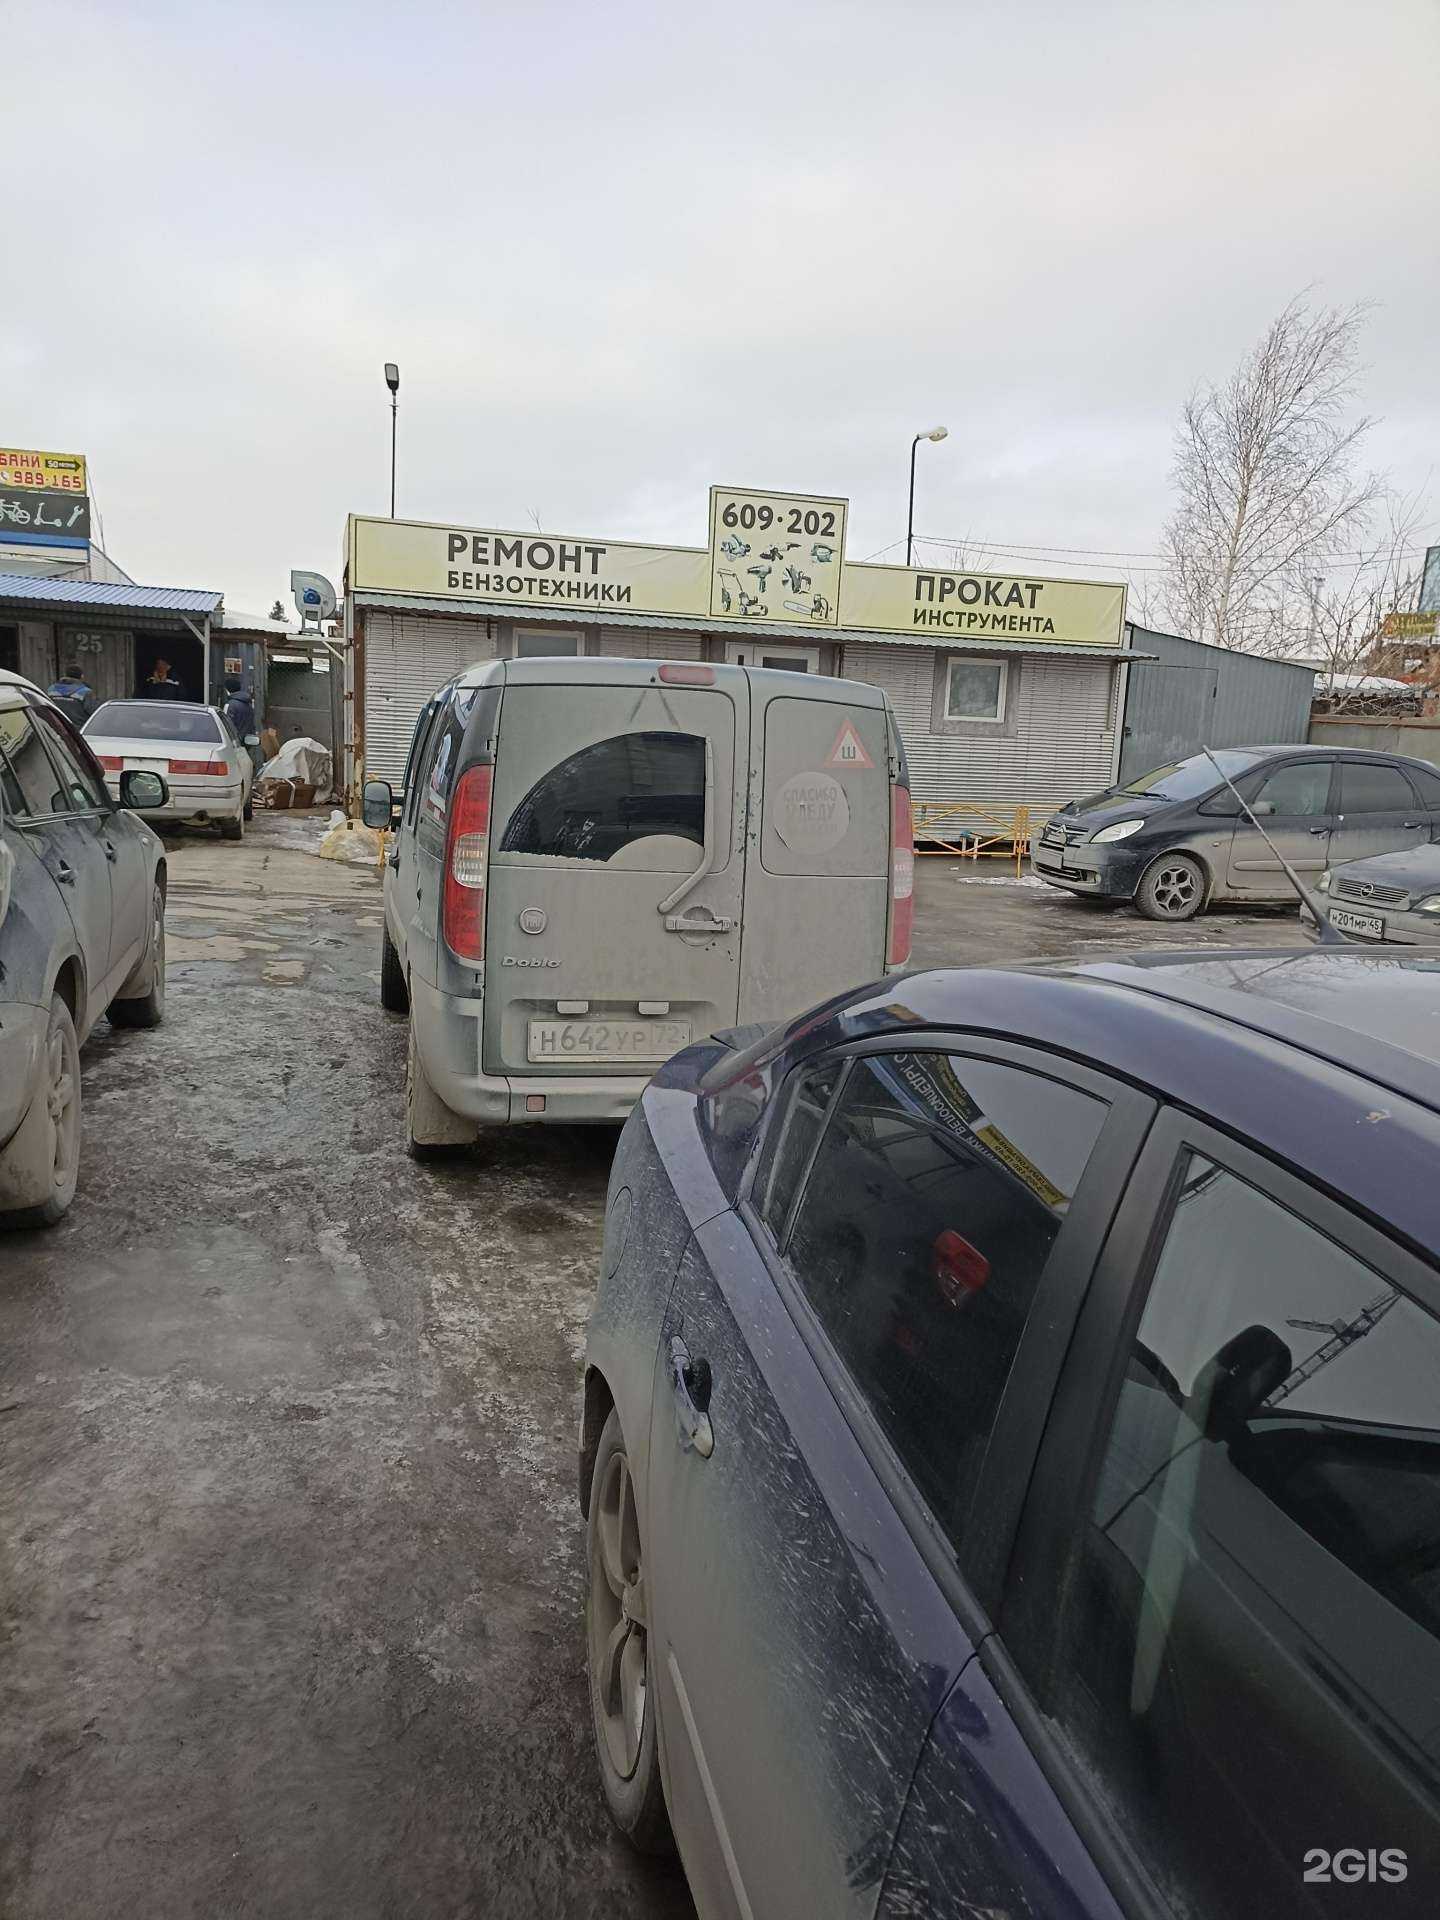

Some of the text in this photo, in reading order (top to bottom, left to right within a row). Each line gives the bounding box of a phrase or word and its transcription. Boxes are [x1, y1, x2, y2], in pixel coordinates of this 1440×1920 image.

[447, 533, 607, 575] РЕМОНТ
[447, 570, 632, 603] БЕНЗОТЕХНИКИ
[915, 574, 1044, 609] ПРОКАТ
[912, 608, 1056, 633] ИНСТРУМЕНТА
[76, 633, 103, 652] 25
[841, 745, 856, 760] Ш
[783, 787, 838, 802] СПАСИБО
[502, 956, 562, 968] Doblo
